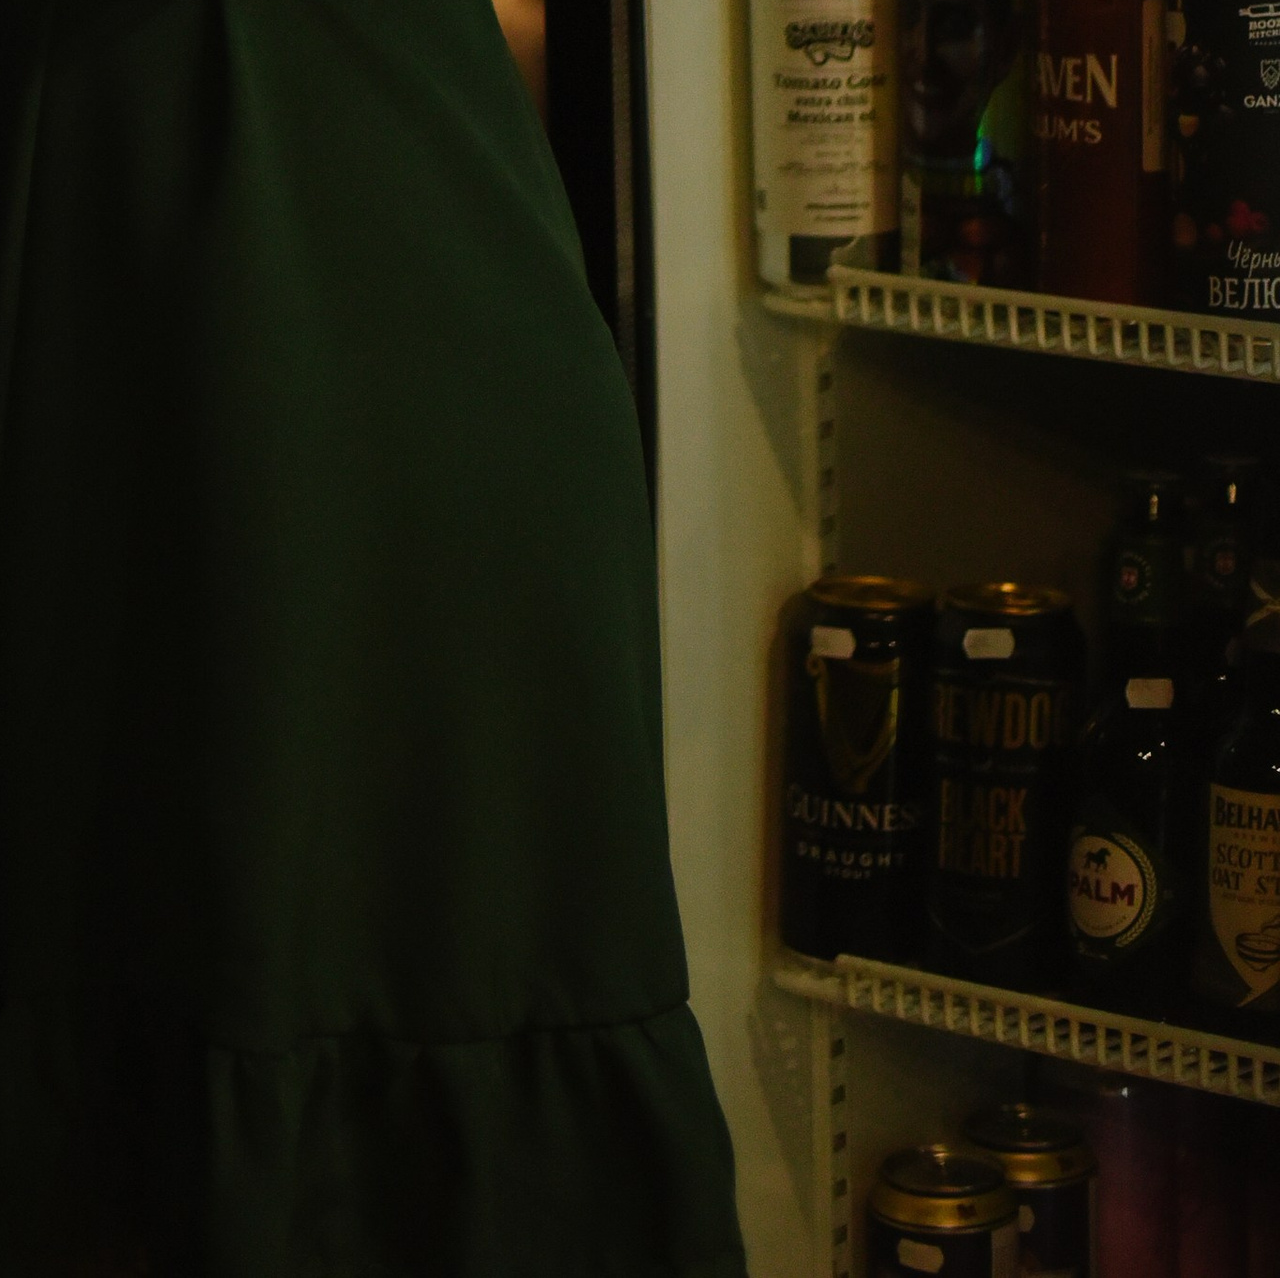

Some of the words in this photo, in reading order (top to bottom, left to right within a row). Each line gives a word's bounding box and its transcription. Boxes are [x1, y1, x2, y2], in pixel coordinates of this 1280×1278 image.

[1214, 795, 1280, 833] BELHA
[796, 840, 905, 868] DRAUGHT
[1070, 870, 1135, 907] PALM
[1211, 866, 1244, 891] OAT
